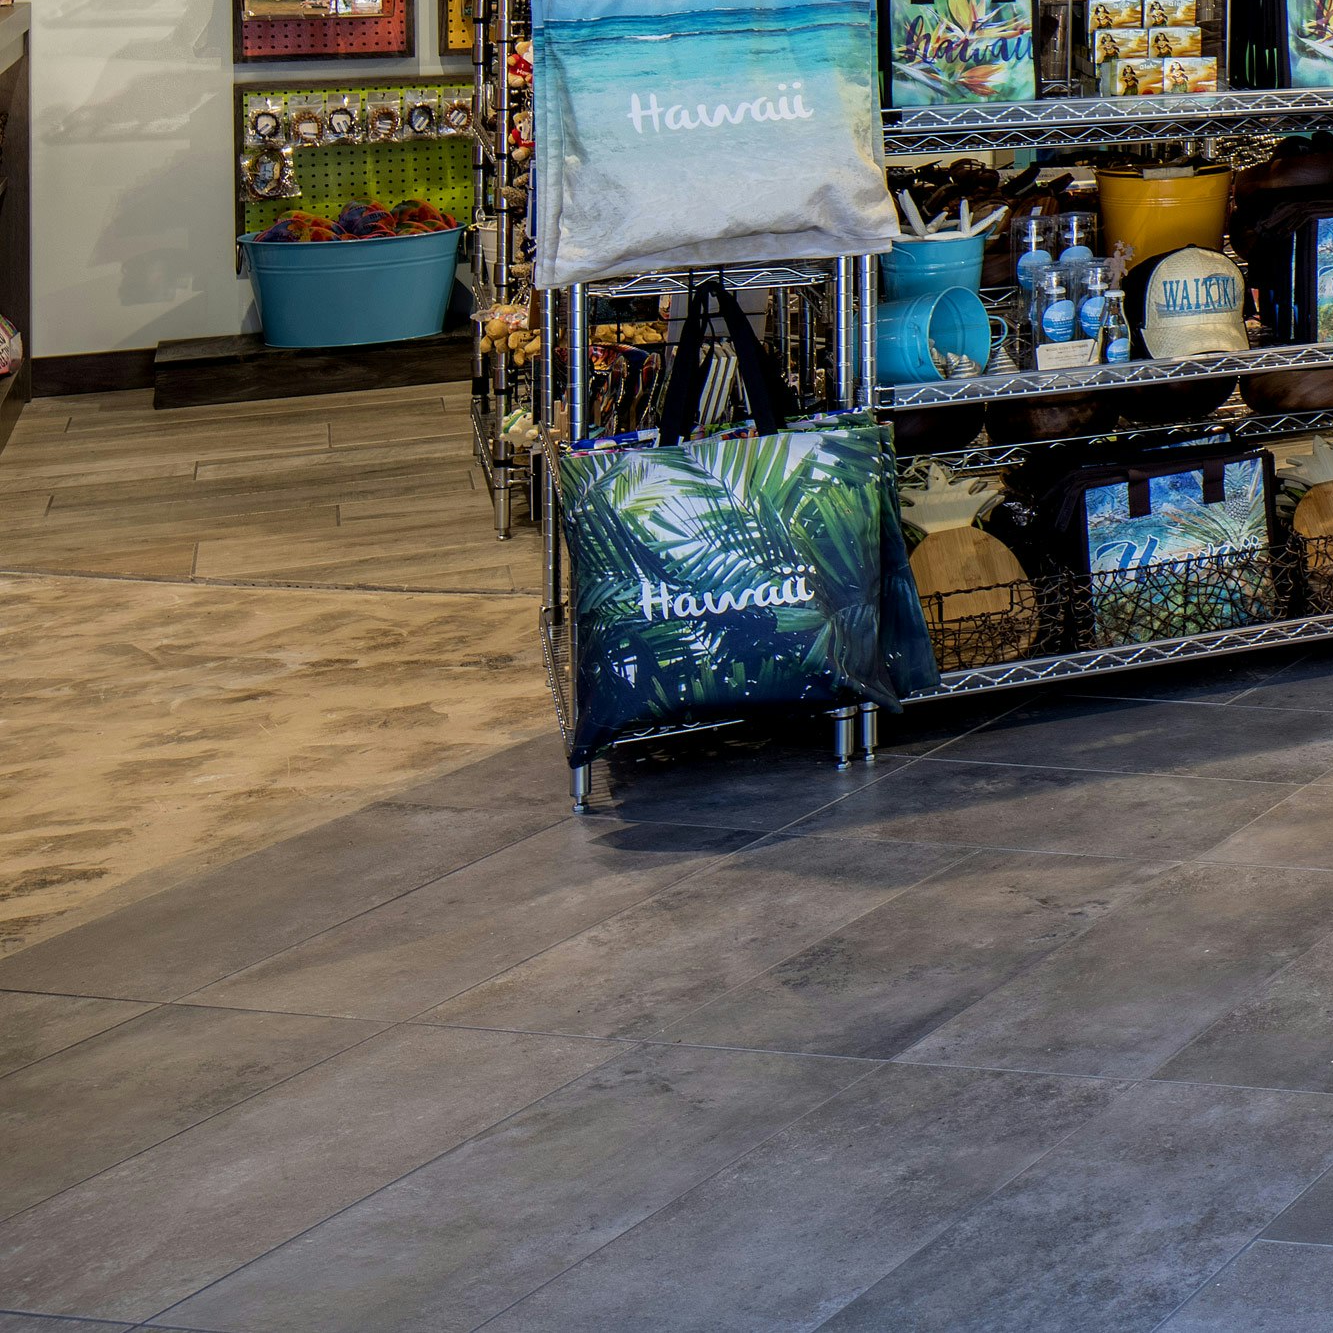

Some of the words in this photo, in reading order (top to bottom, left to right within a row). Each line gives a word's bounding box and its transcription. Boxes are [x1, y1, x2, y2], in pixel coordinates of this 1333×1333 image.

[627, 82, 815, 134] Hawaii
[1162, 275, 1238, 311] WAIKIKI
[637, 565, 816, 621] Hawaii
